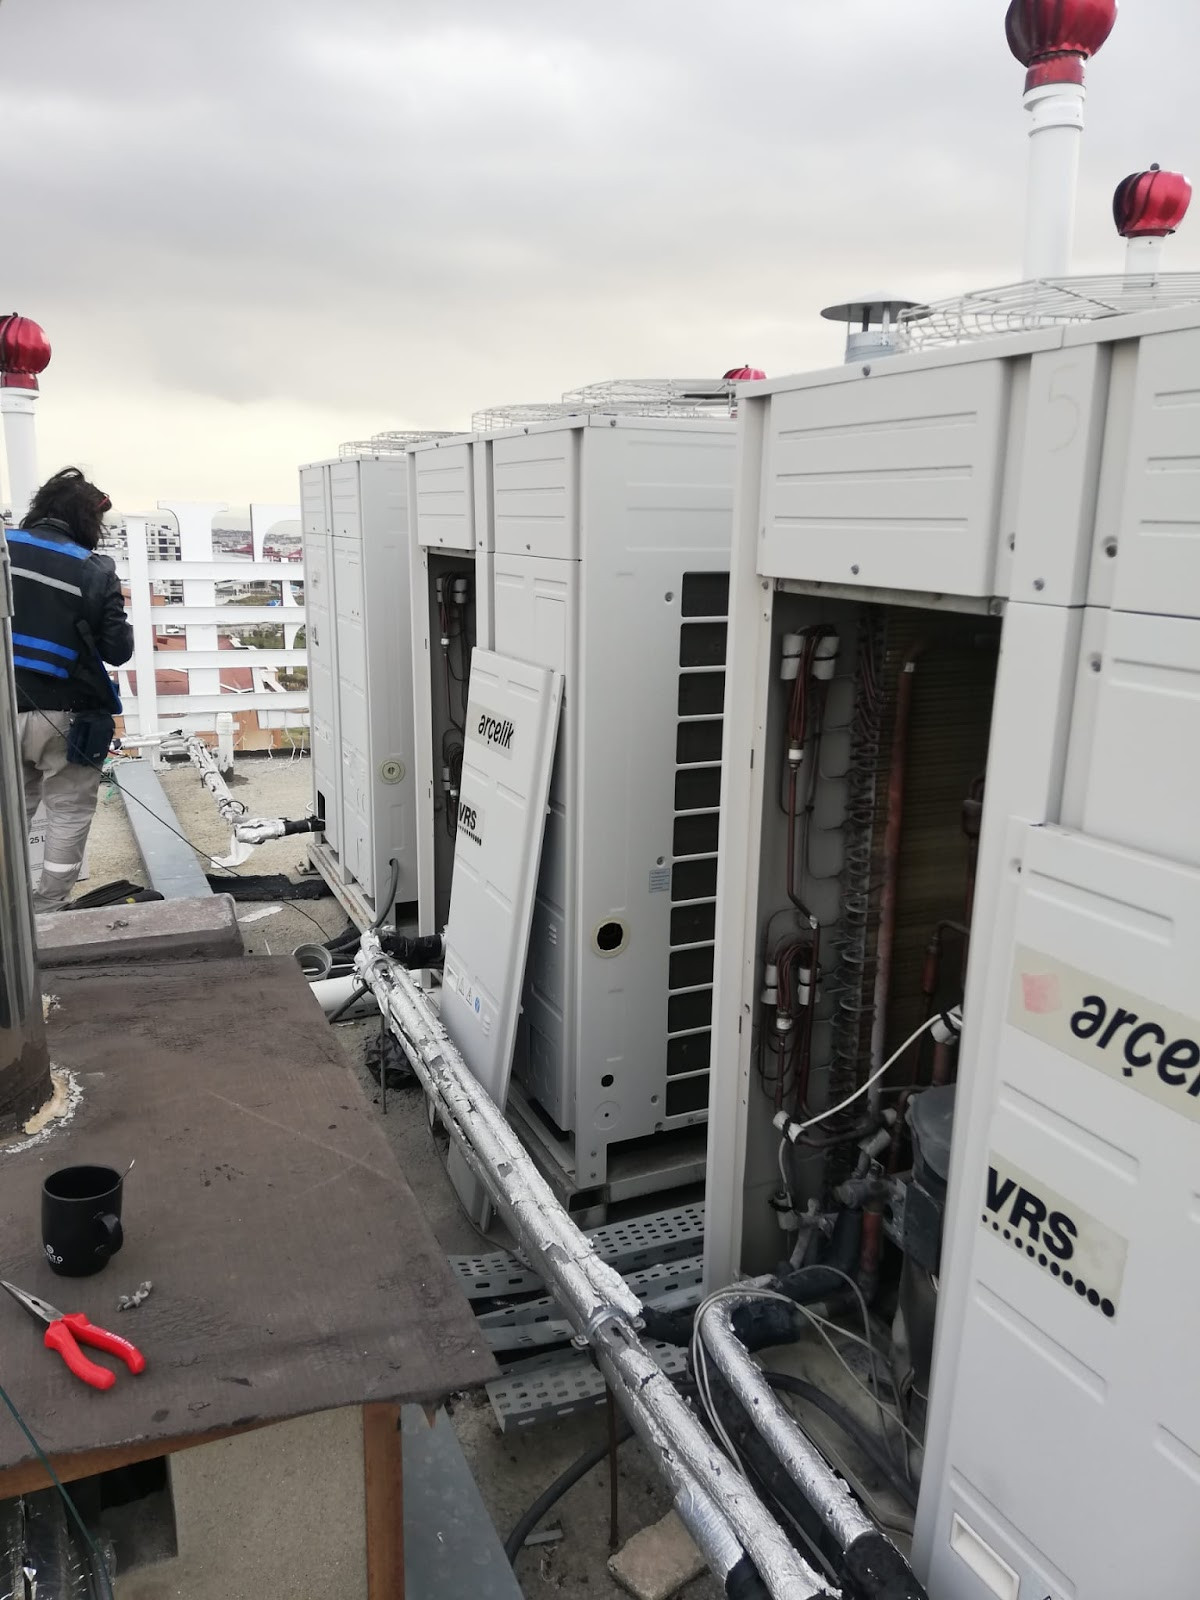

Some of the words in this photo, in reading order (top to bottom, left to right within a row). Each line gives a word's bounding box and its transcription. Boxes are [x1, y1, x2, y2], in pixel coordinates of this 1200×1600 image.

[1048, 362, 1082, 453] 5
[478, 715, 514, 749] arçelik
[459, 802, 477, 830] VRS
[985, 1165, 1077, 1260] VRS
